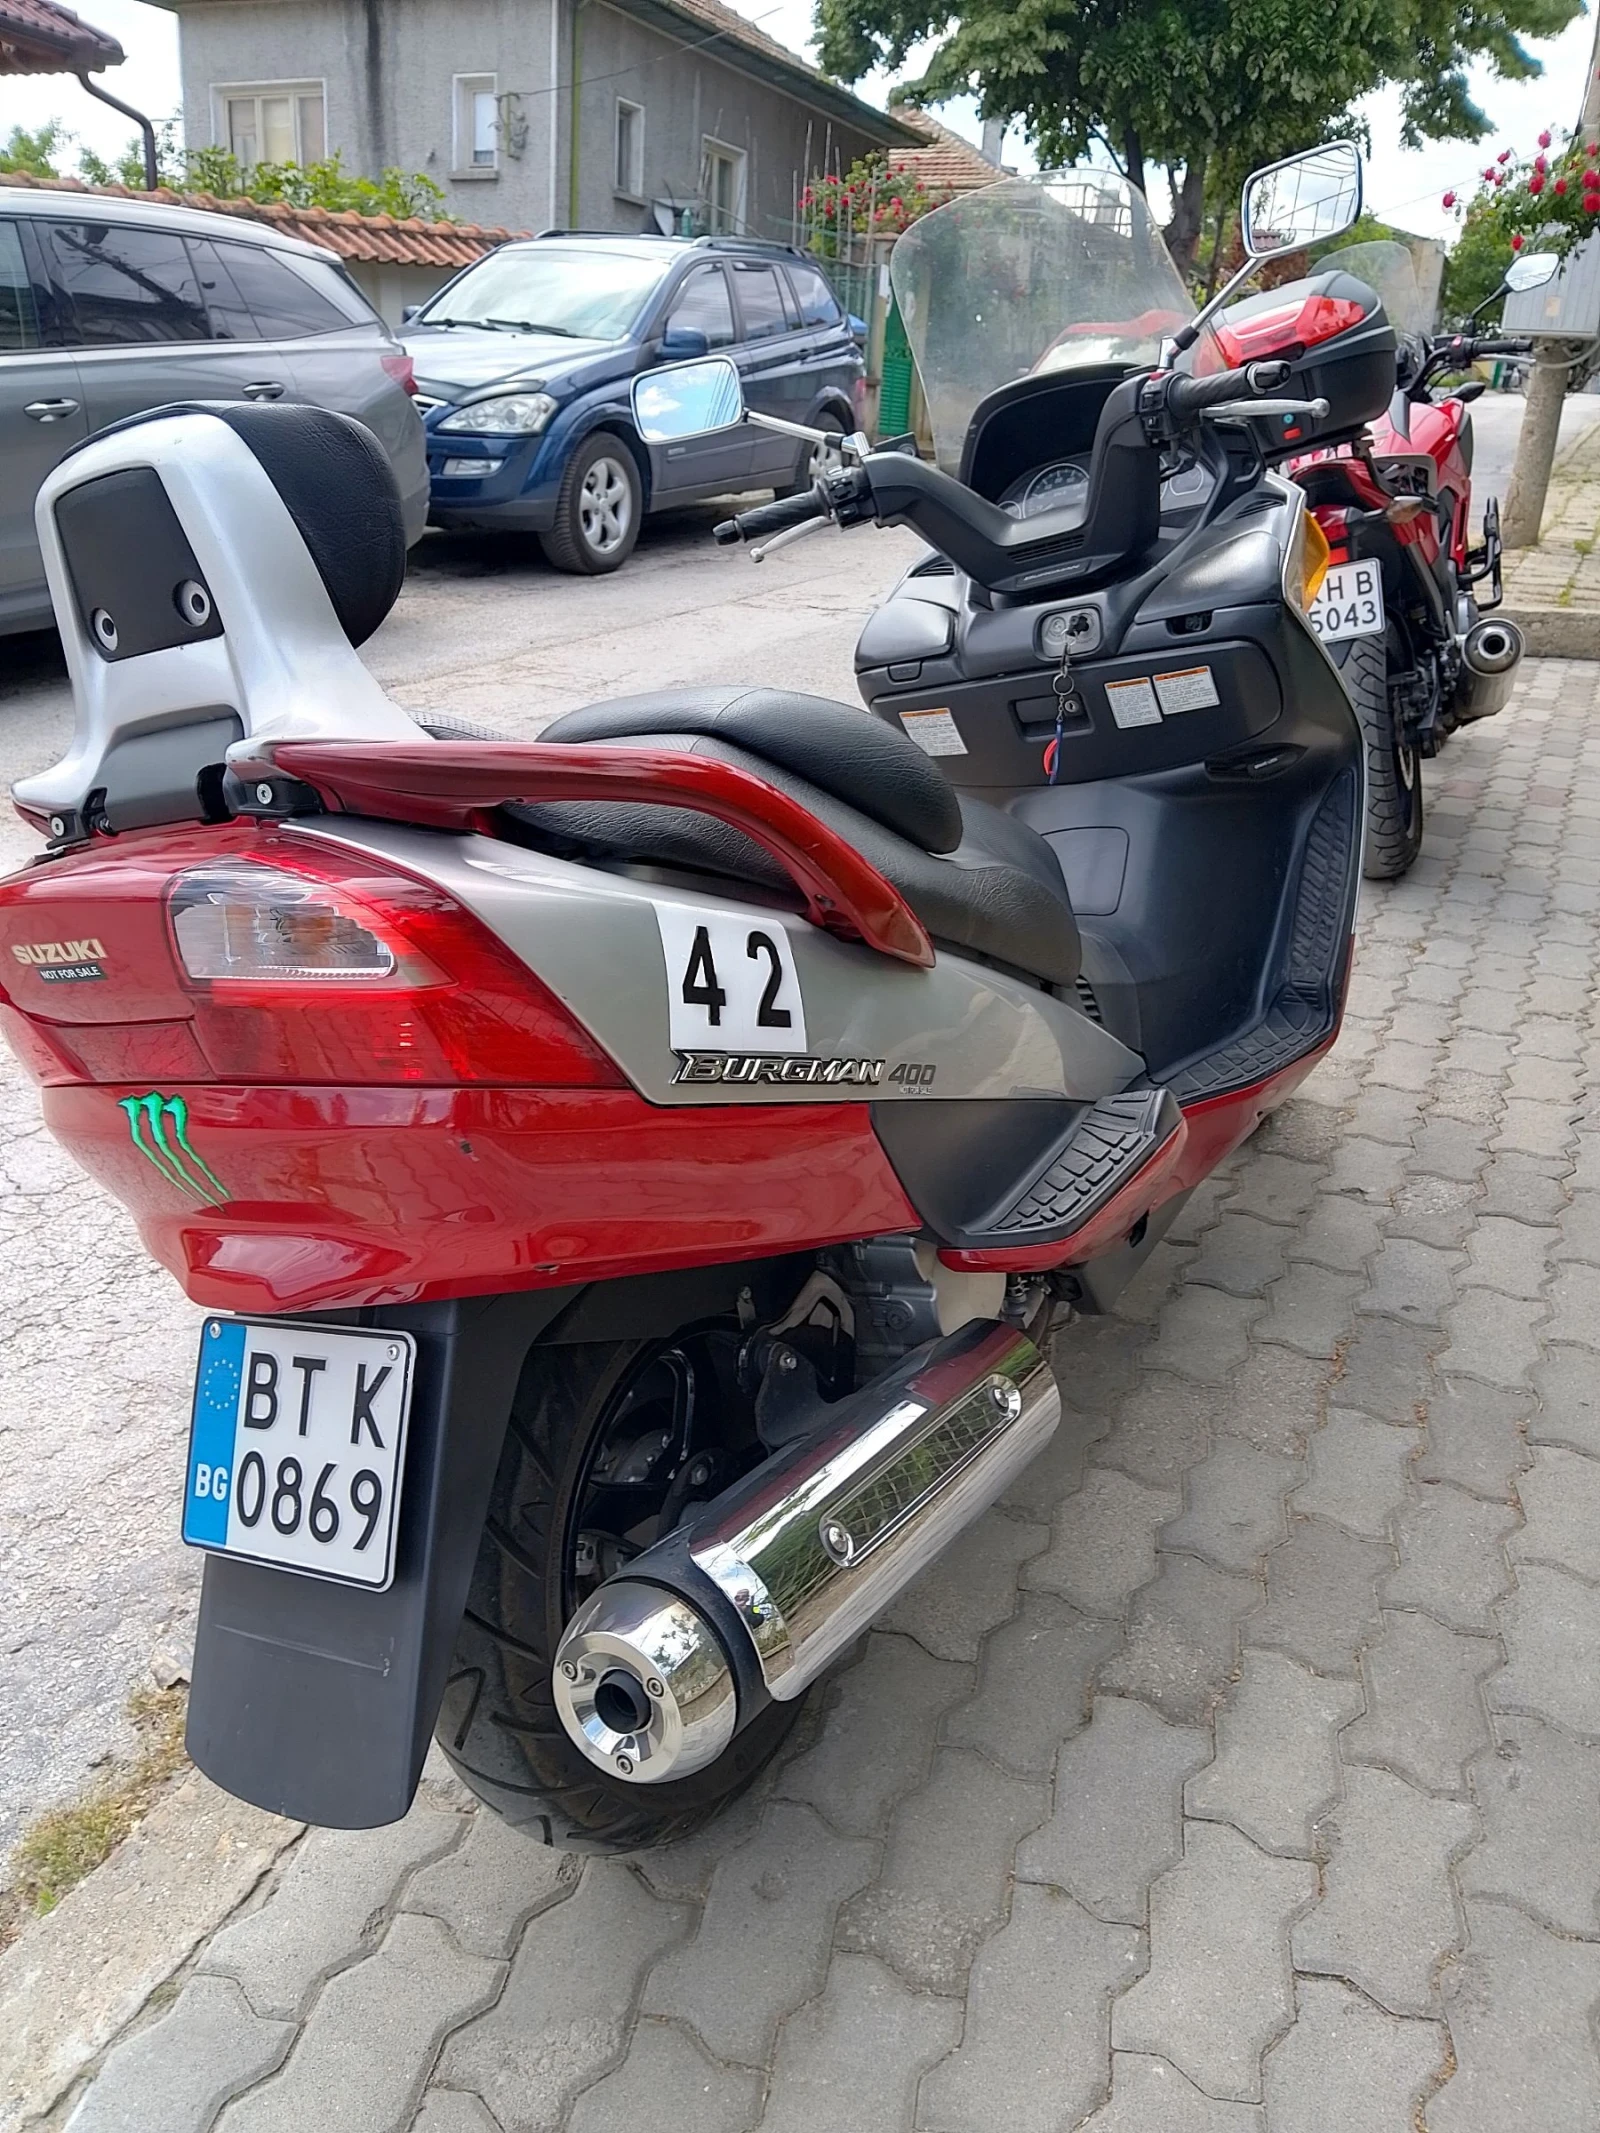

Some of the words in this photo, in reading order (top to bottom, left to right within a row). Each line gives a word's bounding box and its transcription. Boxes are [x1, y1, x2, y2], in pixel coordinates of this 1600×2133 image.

[1315, 575, 1344, 604] H
[1356, 570, 1374, 596] B
[1308, 600, 1377, 634] 5043
[11, 938, 108, 965] SUZUKI
[40, 970, 59, 979] NOT
[57, 969, 77, 979] FOR
[75, 966, 101, 977] SALE
[671, 1050, 886, 1085] BURGMAN
[888, 1063, 936, 1085] 400
[194, 1463, 228, 1501] BG
[236, 1451, 382, 1551] 0869
